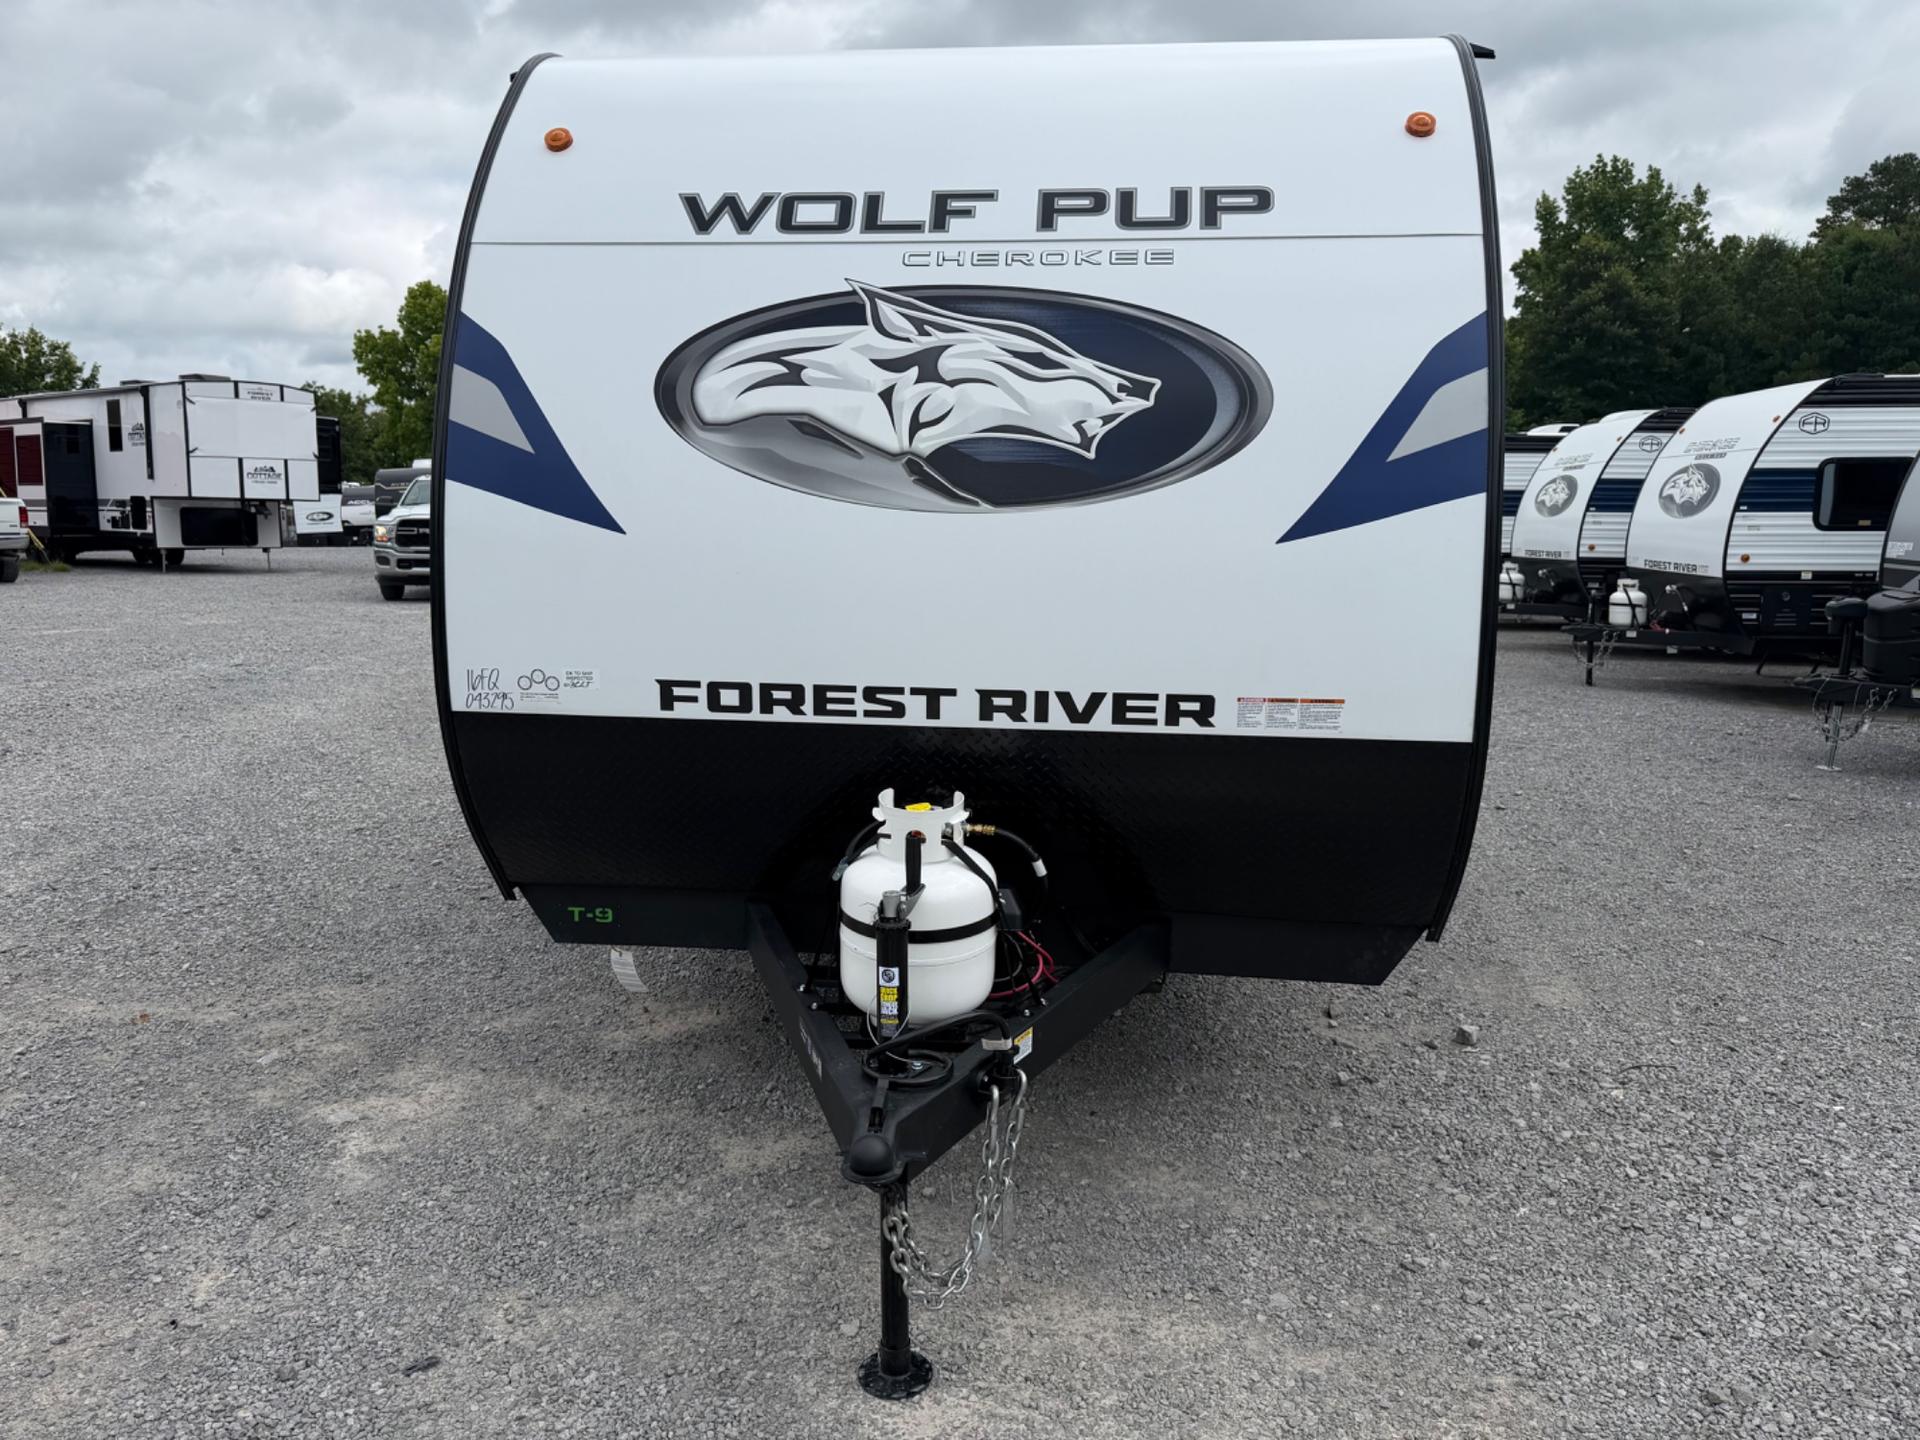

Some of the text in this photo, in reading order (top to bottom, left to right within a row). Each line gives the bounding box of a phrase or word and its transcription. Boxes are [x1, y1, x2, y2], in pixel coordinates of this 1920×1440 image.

[678, 185, 1276, 236] WOLF PUP
[902, 248, 1175, 267] CHEROKEE
[1644, 559, 1672, 570] FOREST
[1673, 562, 1698, 574] RIVER
[654, 678, 958, 721] FOREST
[974, 688, 1217, 729] RIVER
[567, 906, 614, 923] T-9
